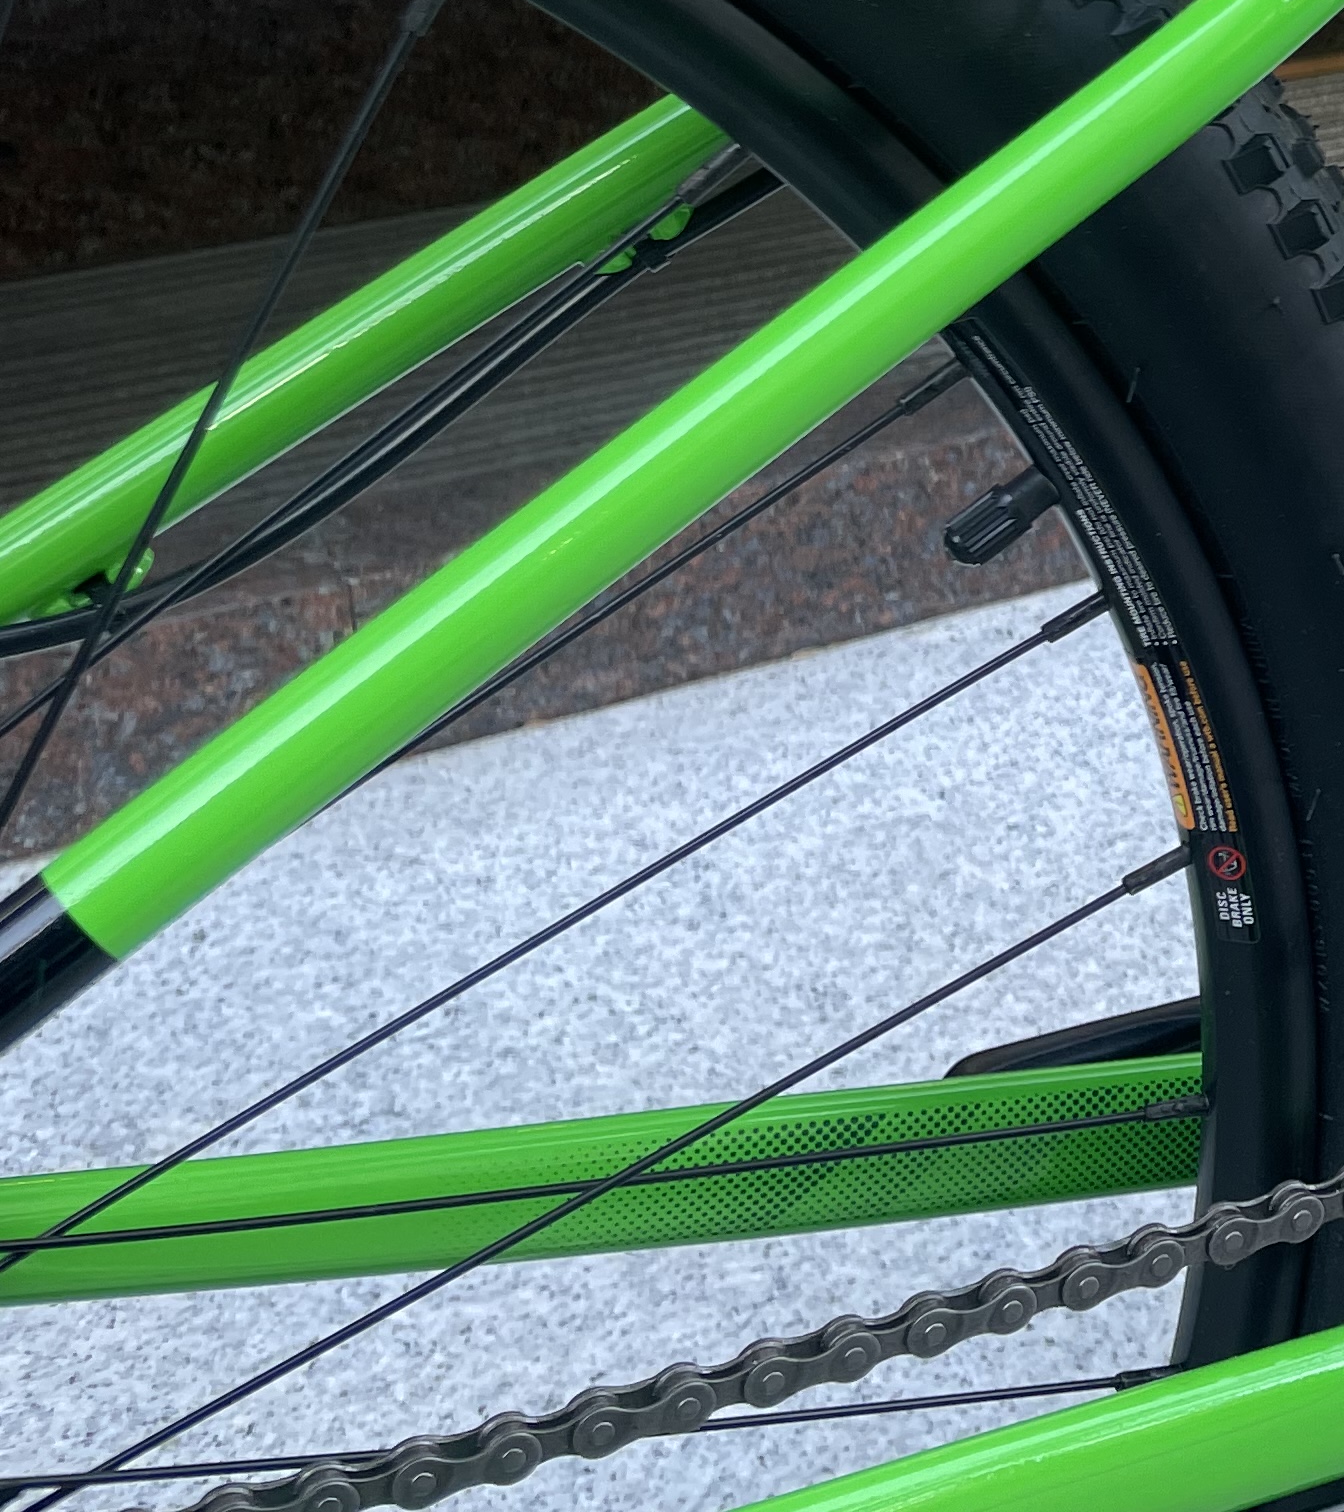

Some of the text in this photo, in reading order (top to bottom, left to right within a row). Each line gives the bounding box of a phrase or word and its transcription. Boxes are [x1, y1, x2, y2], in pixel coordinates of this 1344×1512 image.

[1075, 509, 1151, 645] TIRE MOUNTING INSTRUCTIONS
[1216, 891, 1230, 921] DISC
[1227, 887, 1243, 927] BRAKE
[1240, 893, 1255, 925] ONLY
